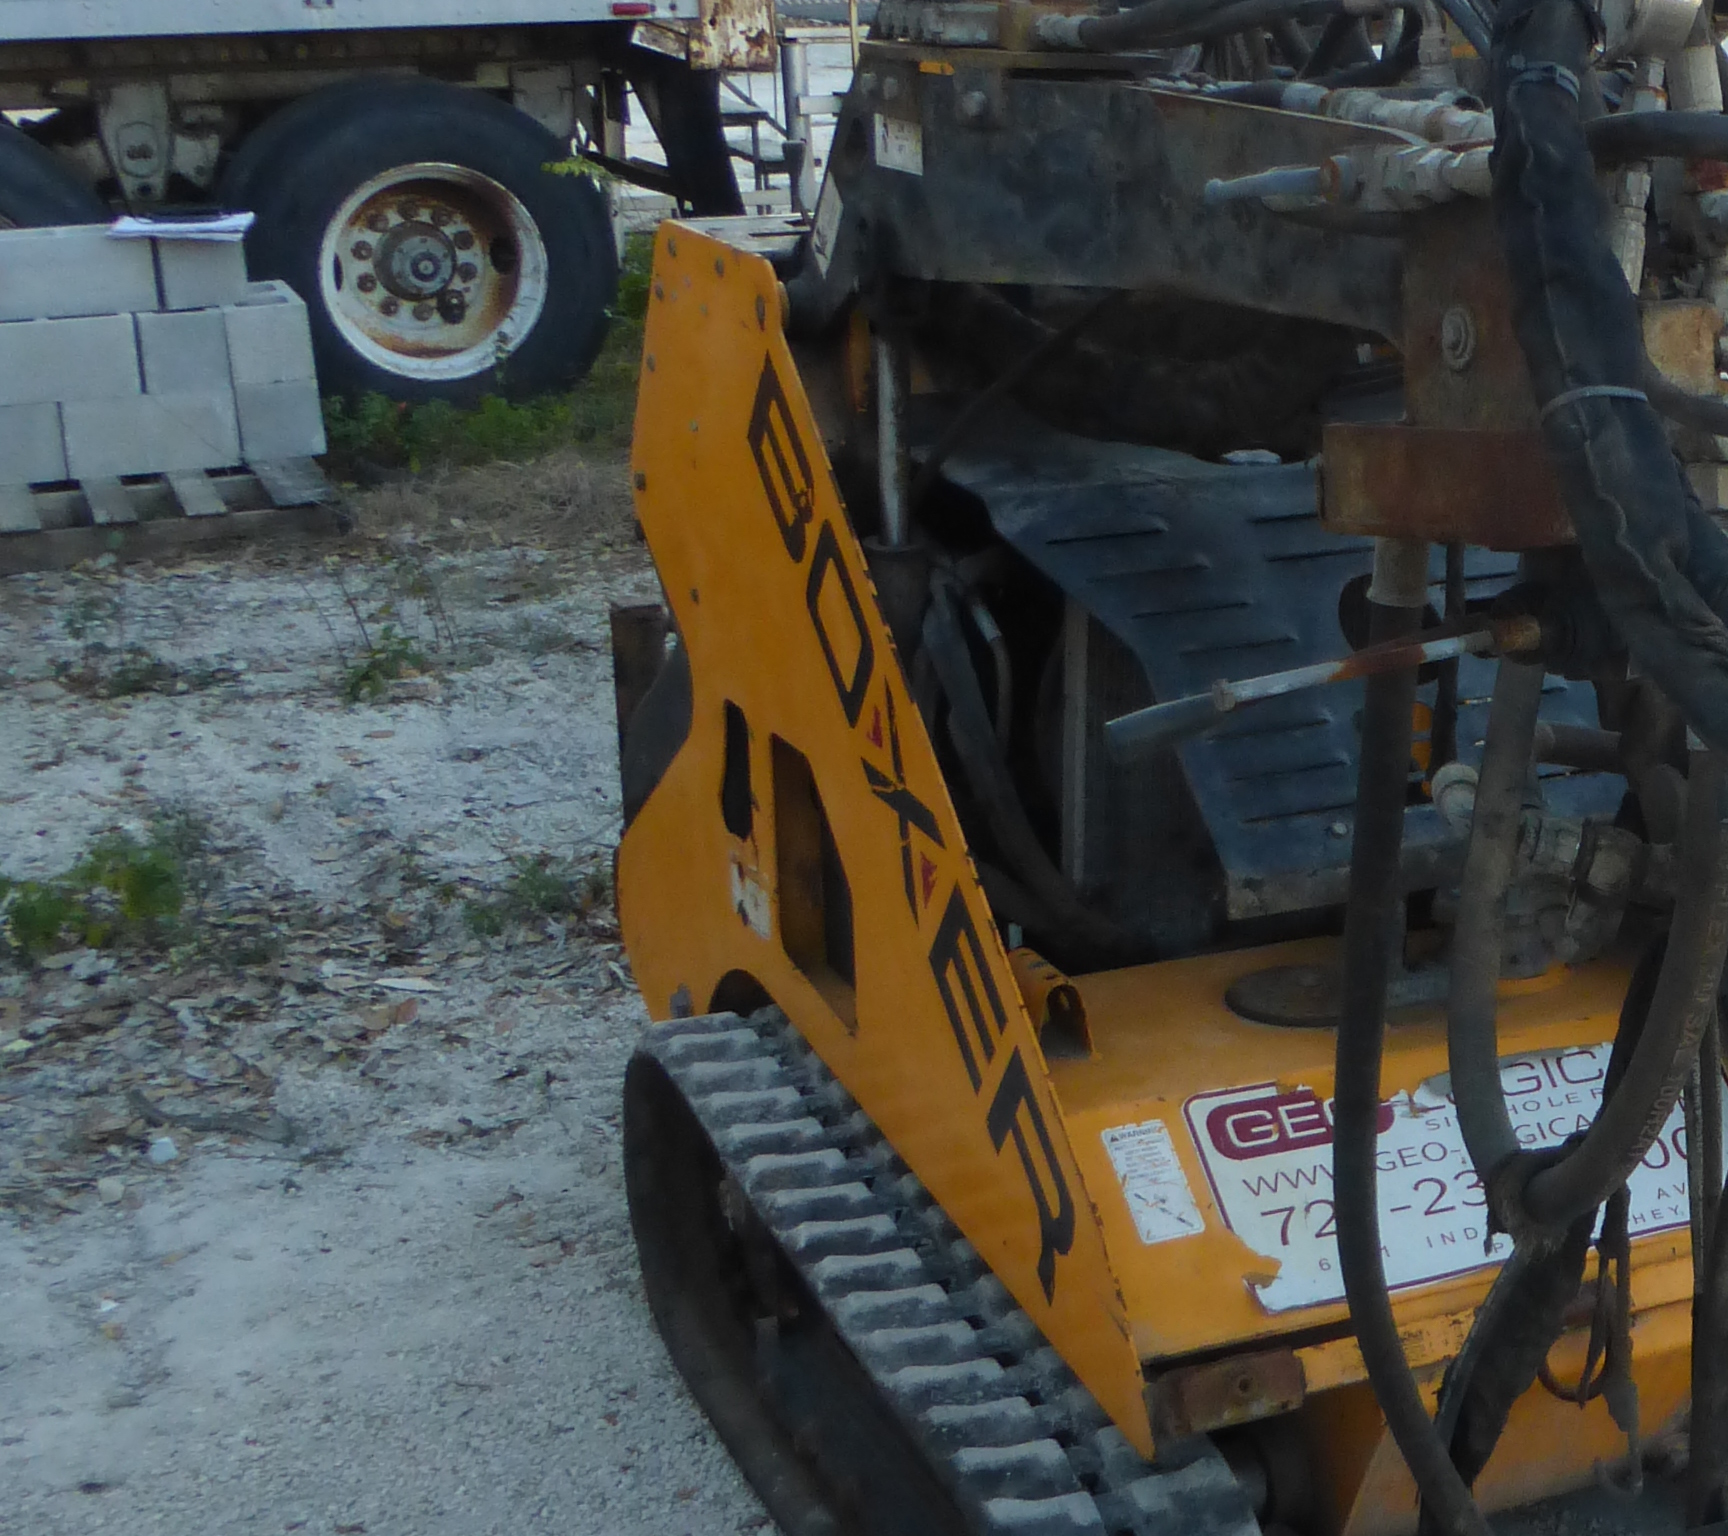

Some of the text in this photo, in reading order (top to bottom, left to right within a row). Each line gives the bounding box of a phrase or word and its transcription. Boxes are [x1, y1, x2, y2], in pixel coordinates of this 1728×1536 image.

[747, 351, 1075, 1307] BOXER
[1226, 1097, 1335, 1148] GE
[1657, 1181, 1686, 1200] AV
